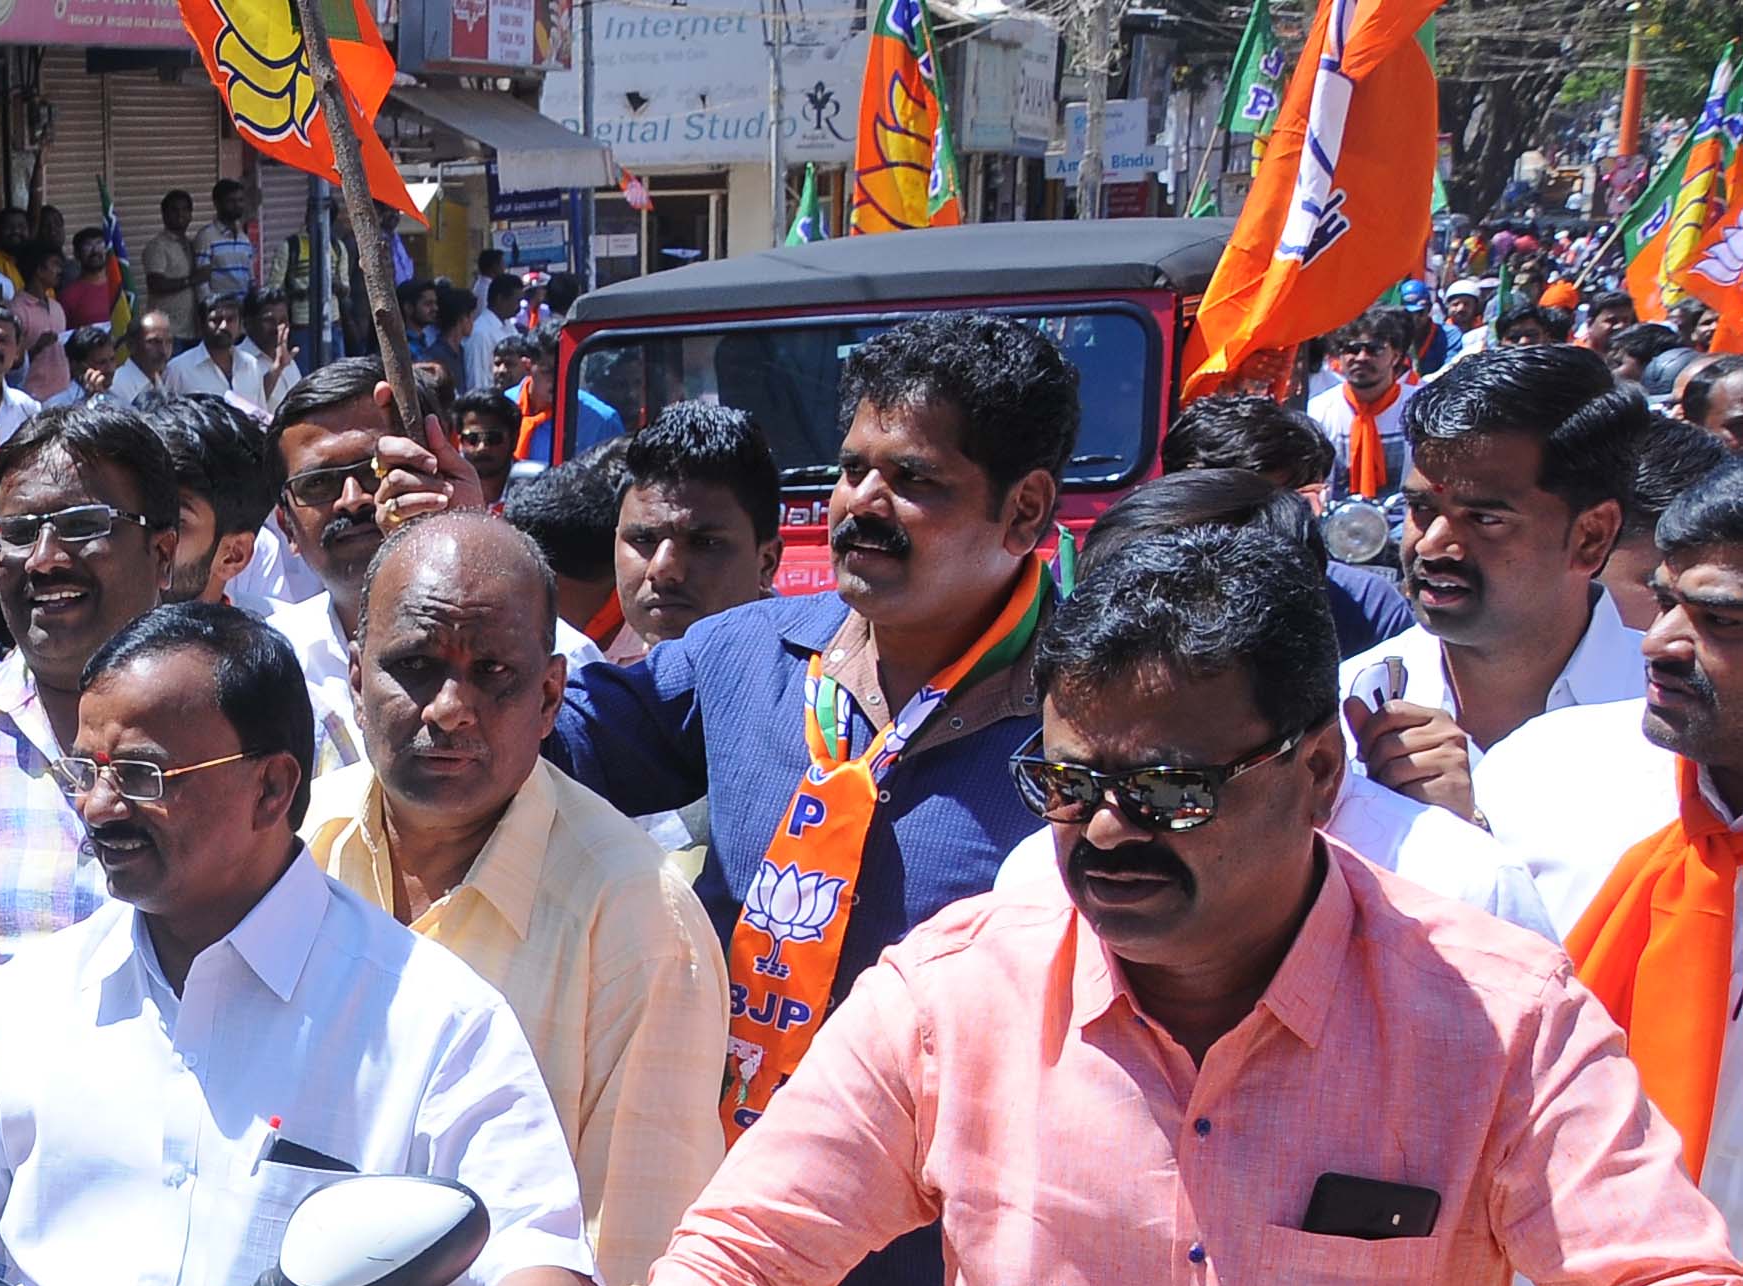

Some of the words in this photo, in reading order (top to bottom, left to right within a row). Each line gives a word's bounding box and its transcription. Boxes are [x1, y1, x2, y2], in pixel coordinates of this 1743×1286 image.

[605, 12, 748, 39] Internet
[561, 111, 670, 148] Dgital
[1111, 154, 1154, 169] Bindu
